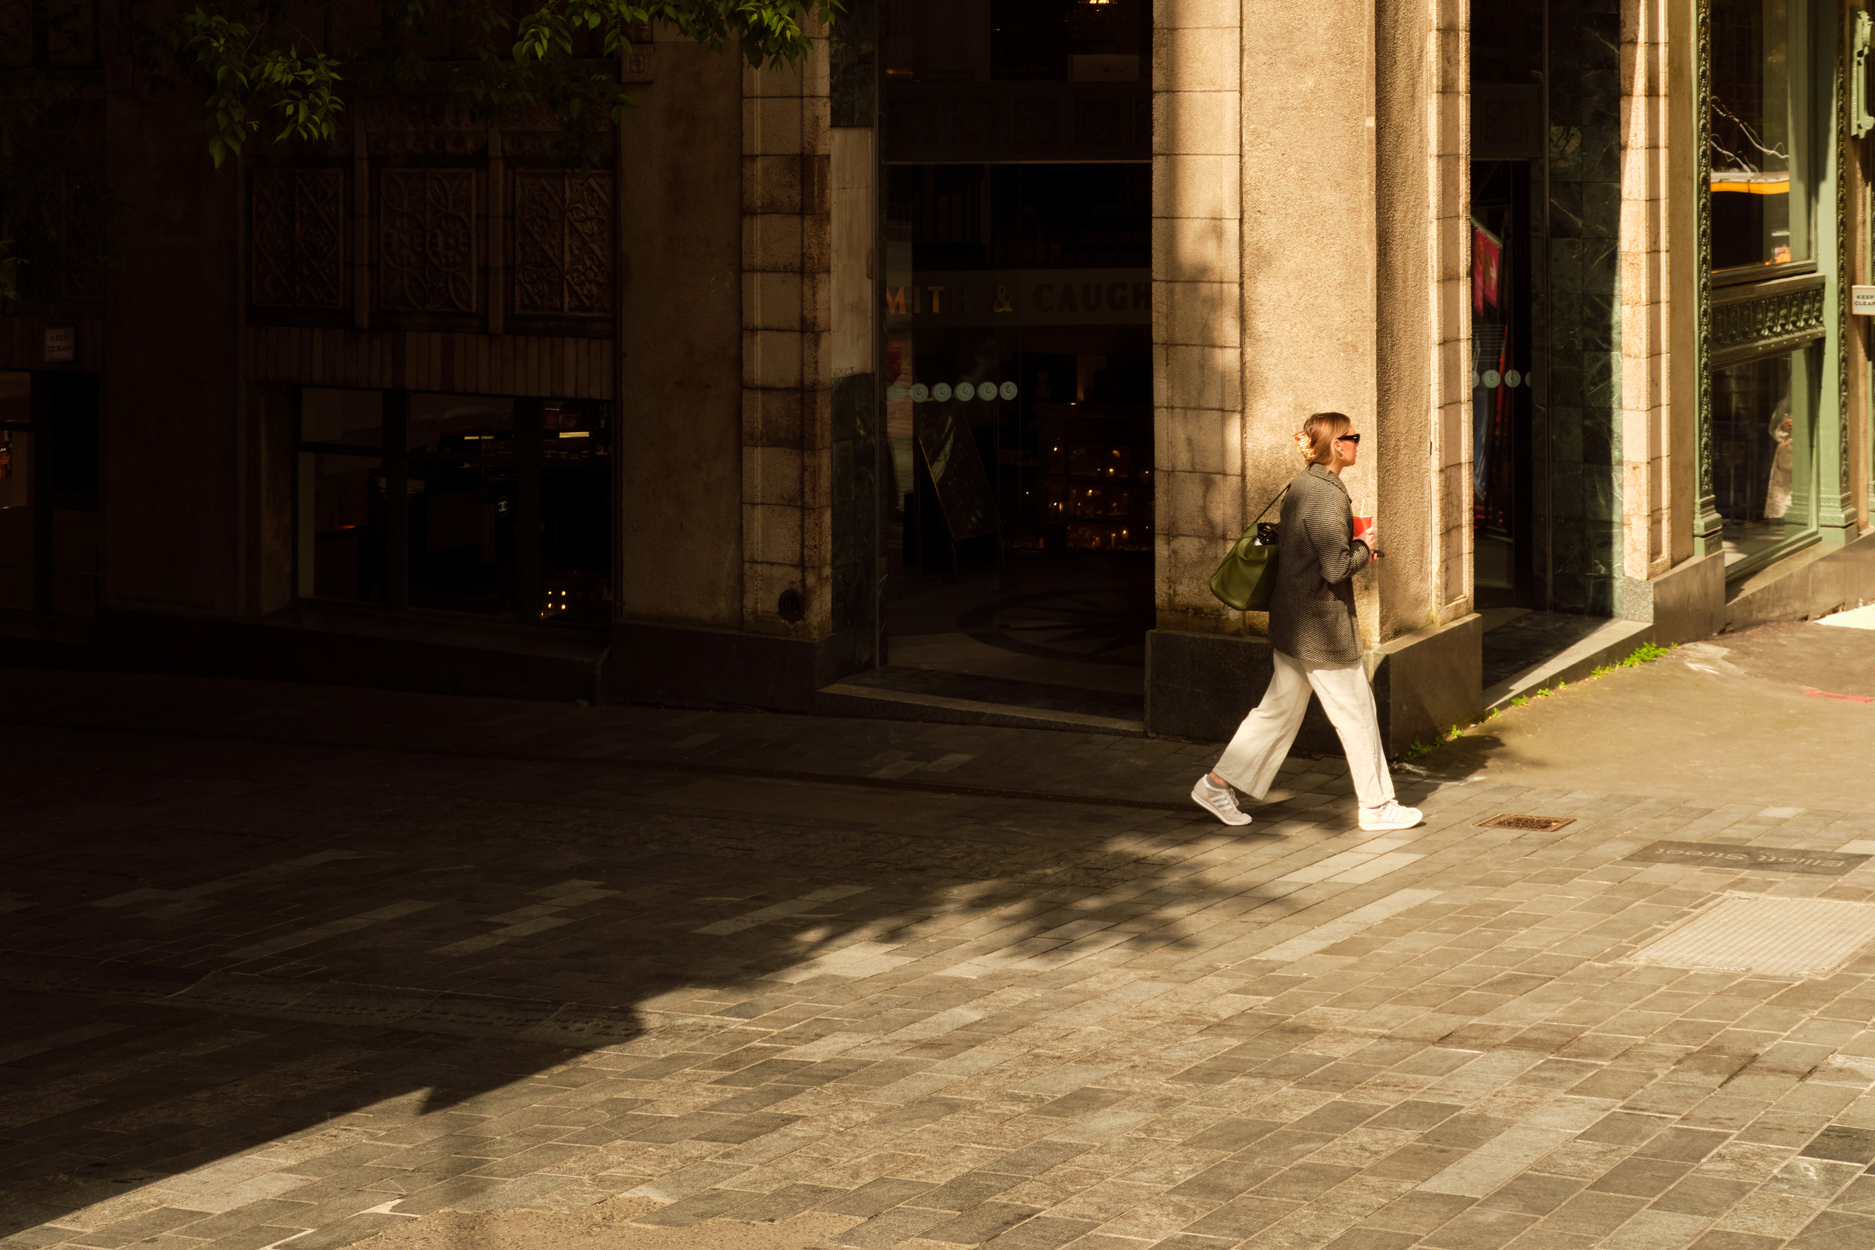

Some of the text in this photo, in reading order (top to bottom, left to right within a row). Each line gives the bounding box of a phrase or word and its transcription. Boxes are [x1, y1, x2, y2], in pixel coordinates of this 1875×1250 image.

[992, 284, 1013, 313] &
[50, 334, 69, 342] KEEP
[1654, 848, 1846, 867] Elliott Street
